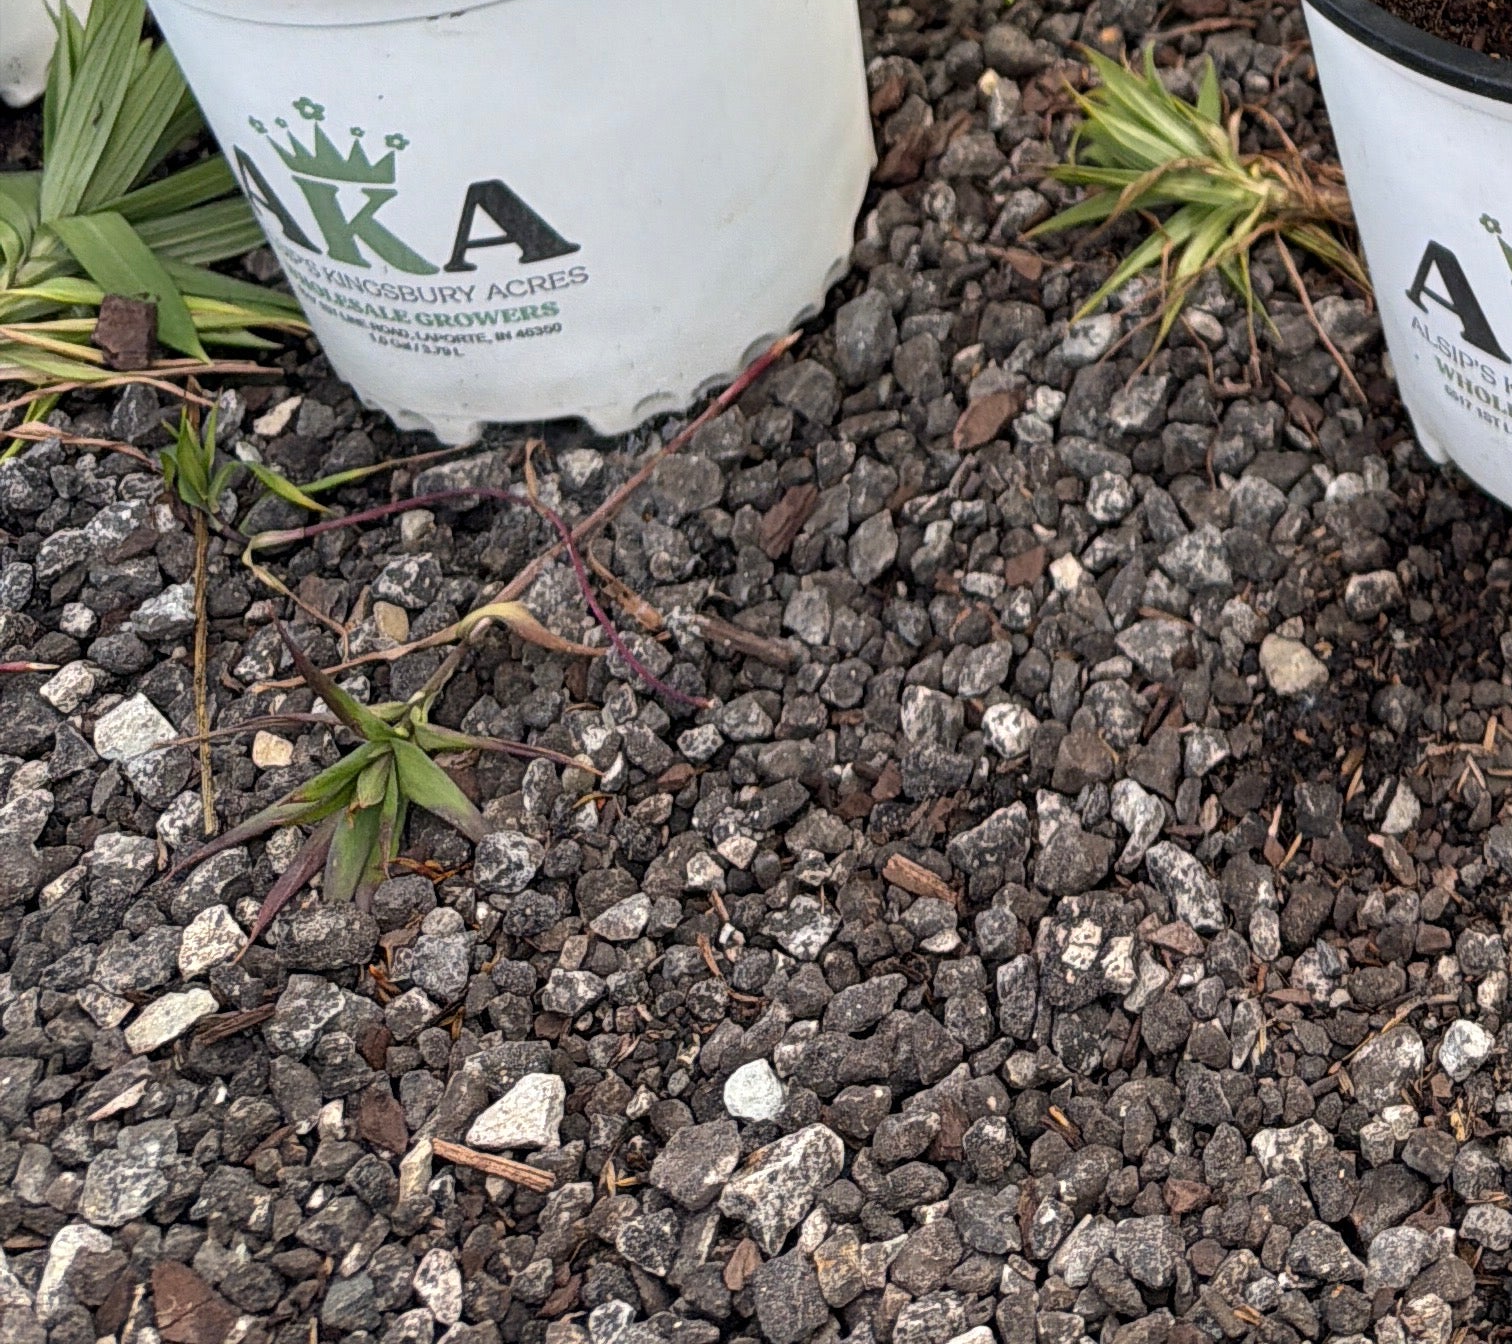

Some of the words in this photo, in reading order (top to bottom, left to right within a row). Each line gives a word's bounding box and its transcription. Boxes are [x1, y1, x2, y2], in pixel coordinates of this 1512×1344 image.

[234, 144, 581, 275] AKA
[322, 265, 476, 304] KINGSBURY
[487, 265, 590, 302] ACRES
[414, 301, 560, 327] GROWERS
[495, 330, 513, 342] IN
[1411, 316, 1497, 386] ALSIP'S
